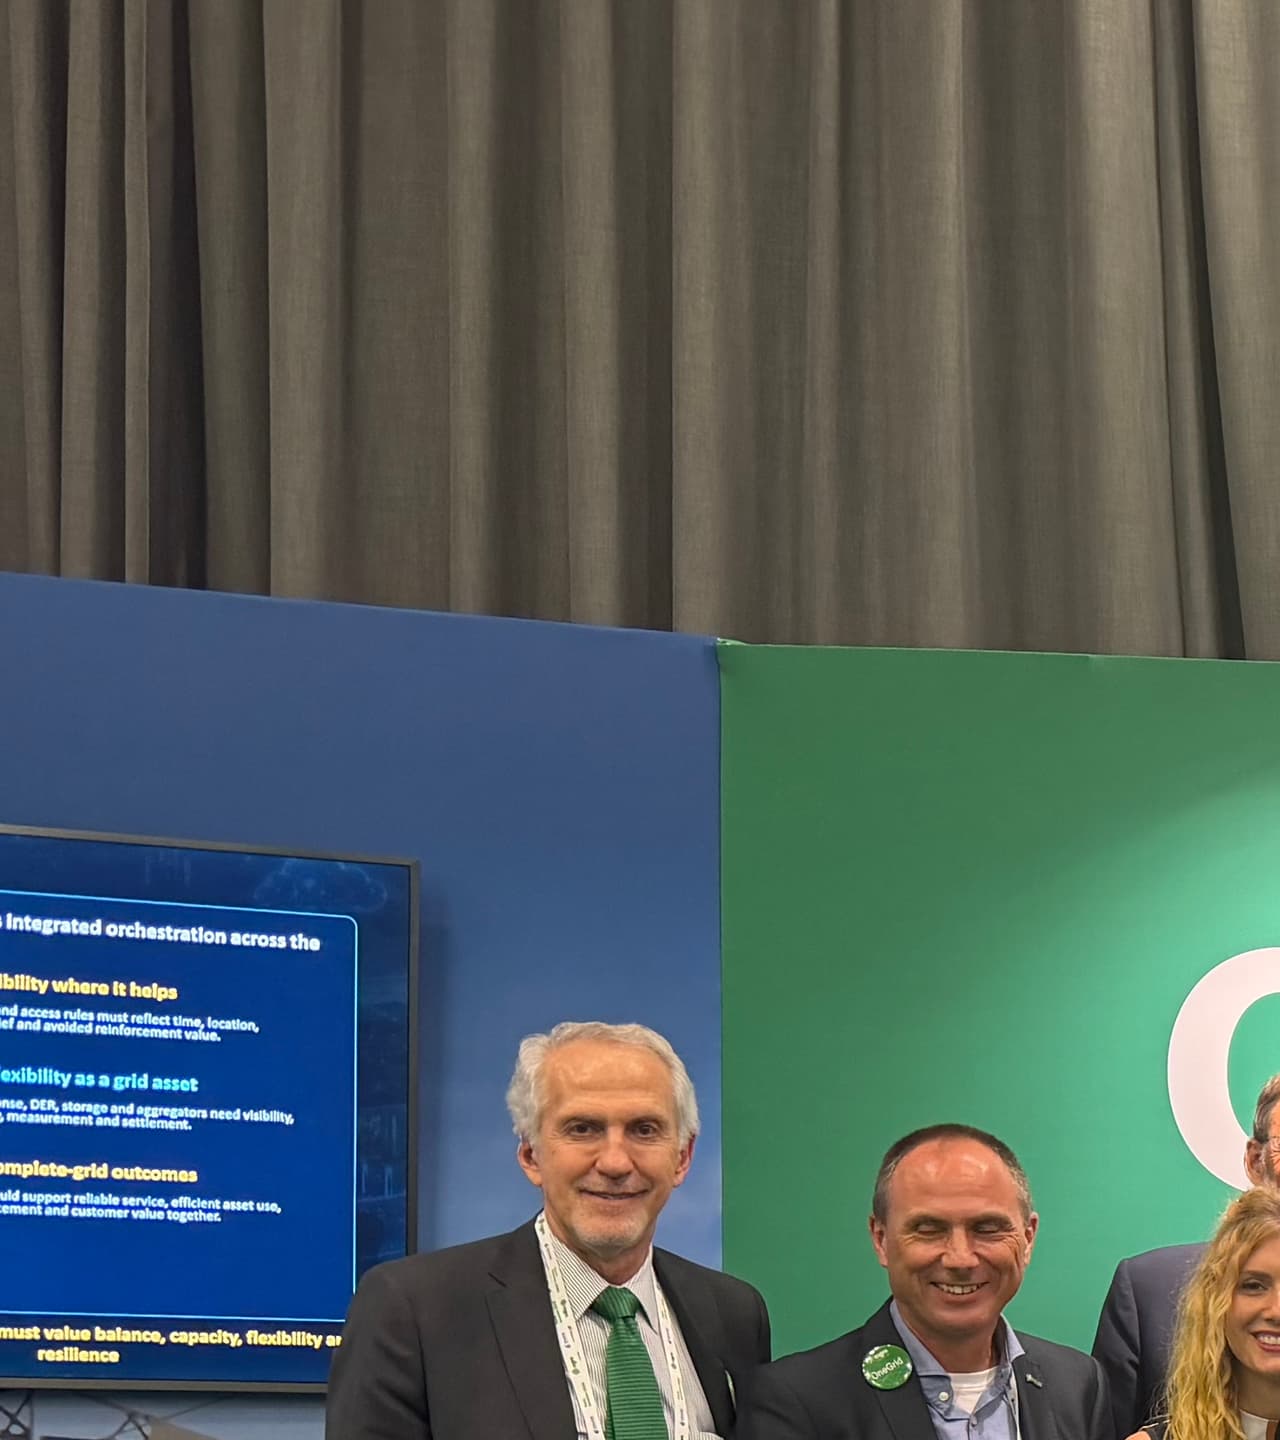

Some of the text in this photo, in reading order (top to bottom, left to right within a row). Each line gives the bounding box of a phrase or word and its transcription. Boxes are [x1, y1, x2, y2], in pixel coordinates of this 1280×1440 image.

[105, 921, 227, 945] orchestration
[230, 931, 287, 948] across
[289, 933, 321, 951] the
[52, 977, 109, 995] where
[113, 980, 127, 997] it
[130, 981, 178, 1001] helps
[0, 1004, 259, 1033] nd access rules must reflect time, location,
[16, 1019, 41, 1031] and
[43, 1021, 93, 1034] avoided
[95, 1023, 182, 1039] reinforcement
[184, 1029, 221, 1041] value.
[74, 1073, 95, 1087] as
[98, 1074, 110, 1087] a
[113, 1073, 149, 1090] grid
[151, 1077, 199, 1092] asset
[6, 1112, 93, 1126] measurement
[95, 1115, 120, 1127] and
[121, 1116, 192, 1130] settlement.
[30, 1099, 59, 1112] DER,
[61, 1101, 108, 1116] storage
[110, 1103, 134, 1115] and
[136, 1105, 208, 1119] aggregators
[210, 1108, 241, 1121] need
[242, 1109, 294, 1125] visibility,
[111, 1166, 198, 1182] outcomes
[22, 1191, 72, 1205] support
[73, 1192, 120, 1206] reliable
[121, 1195, 168, 1209] service,
[170, 1196, 221, 1210] efficient
[222, 1200, 255, 1211] asset
[256, 1202, 282, 1214] use,
[44, 1204, 69, 1217] and
[70, 1206, 130, 1219] customer
[131, 1207, 165, 1220] value
[166, 1209, 222, 1224] together.
[43, 1325, 91, 1341] value
[94, 1326, 166, 1345] balance,
[169, 1329, 243, 1347] capacity,
[245, 1330, 323, 1349] flexibility
[37, 1346, 120, 1363] resilience
